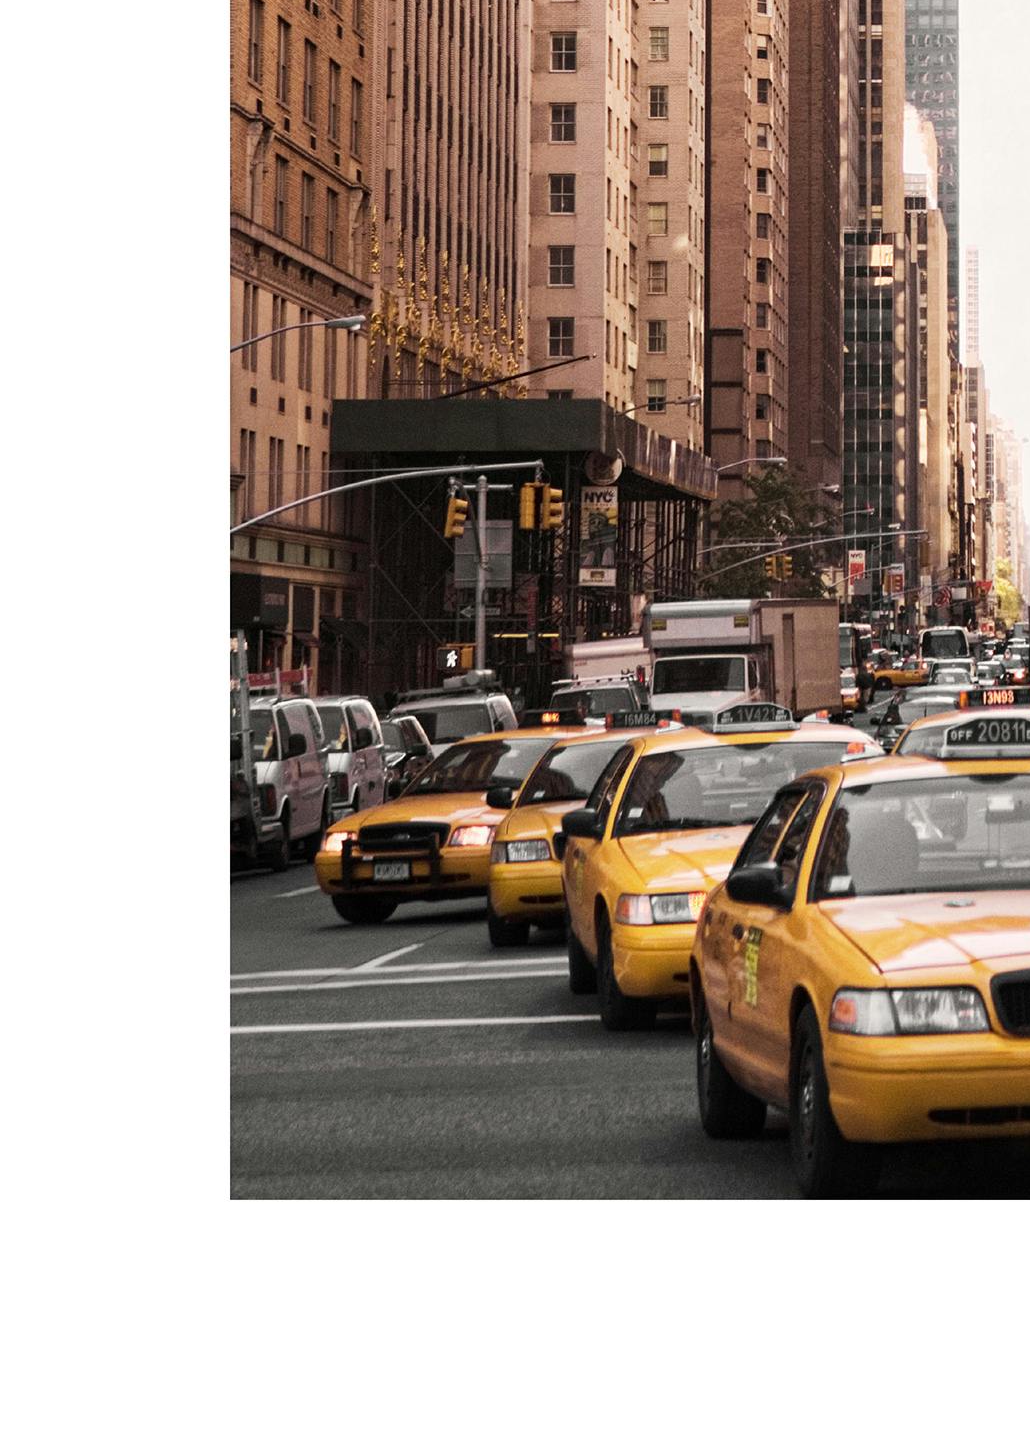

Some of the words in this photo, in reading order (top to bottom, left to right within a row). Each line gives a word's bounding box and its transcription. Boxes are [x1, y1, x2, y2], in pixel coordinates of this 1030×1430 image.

[584, 490, 613, 503] NYC
[950, 730, 973, 741] OFF
[978, 721, 1026, 743] 20811
